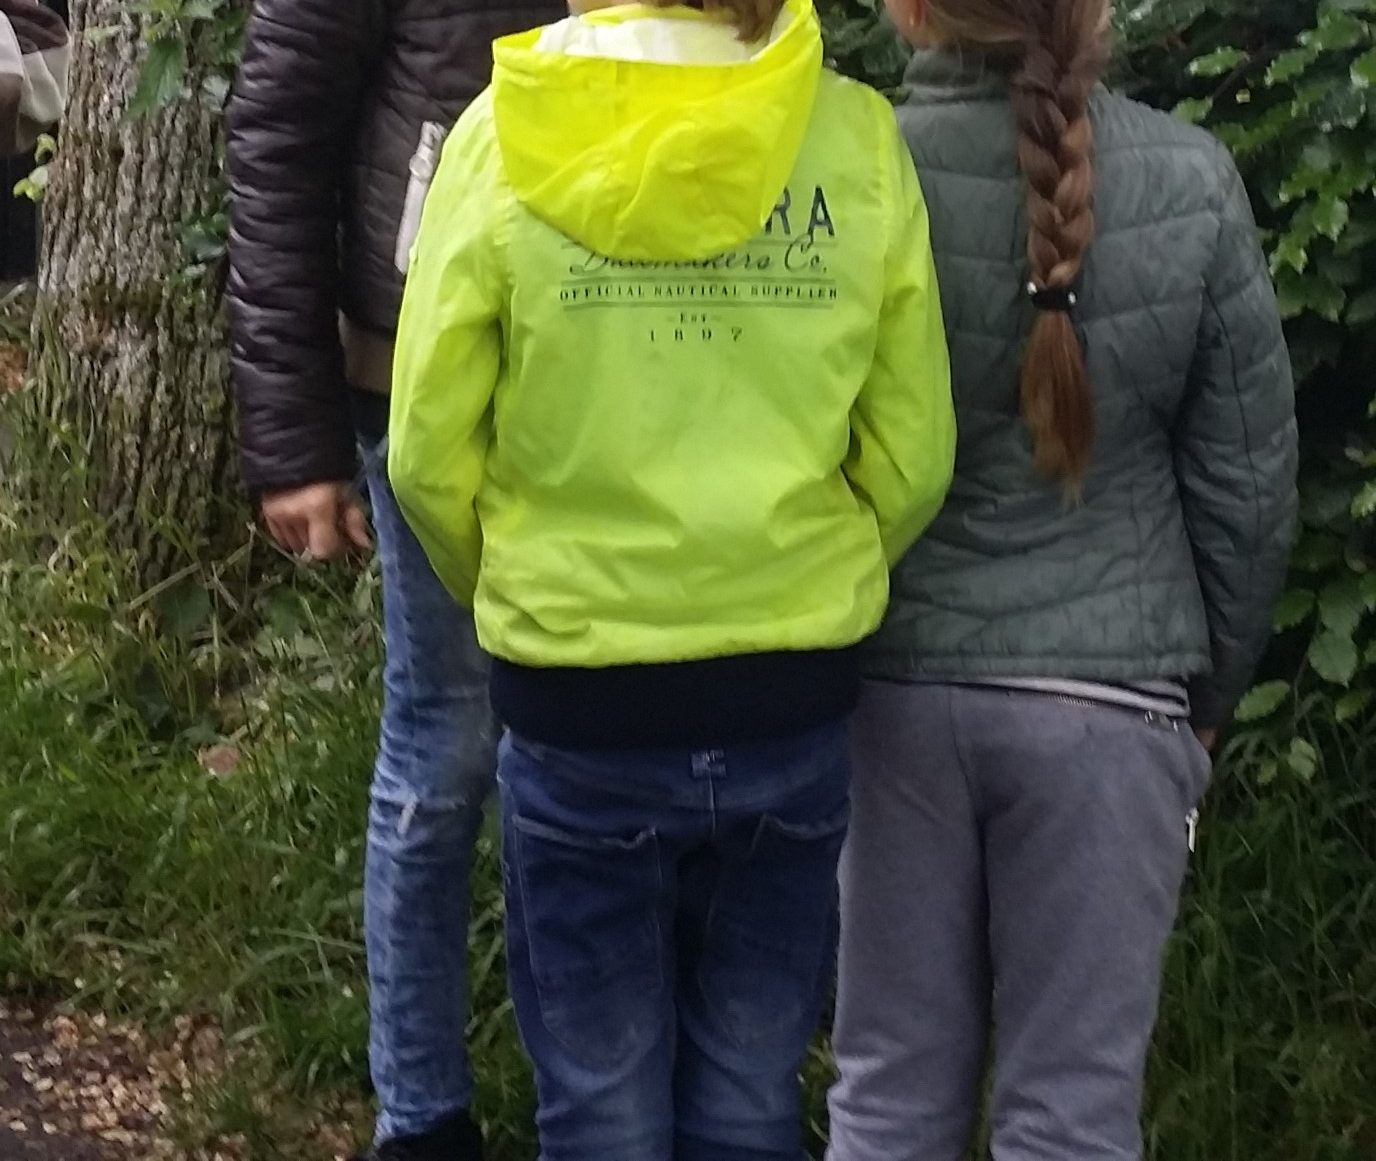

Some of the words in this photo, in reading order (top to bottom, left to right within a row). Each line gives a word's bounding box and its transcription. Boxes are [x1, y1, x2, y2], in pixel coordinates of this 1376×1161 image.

[559, 285, 645, 301] OFFICIAL
[654, 285, 741, 297] NAUTICAL
[750, 285, 837, 300] SUPPLIER
